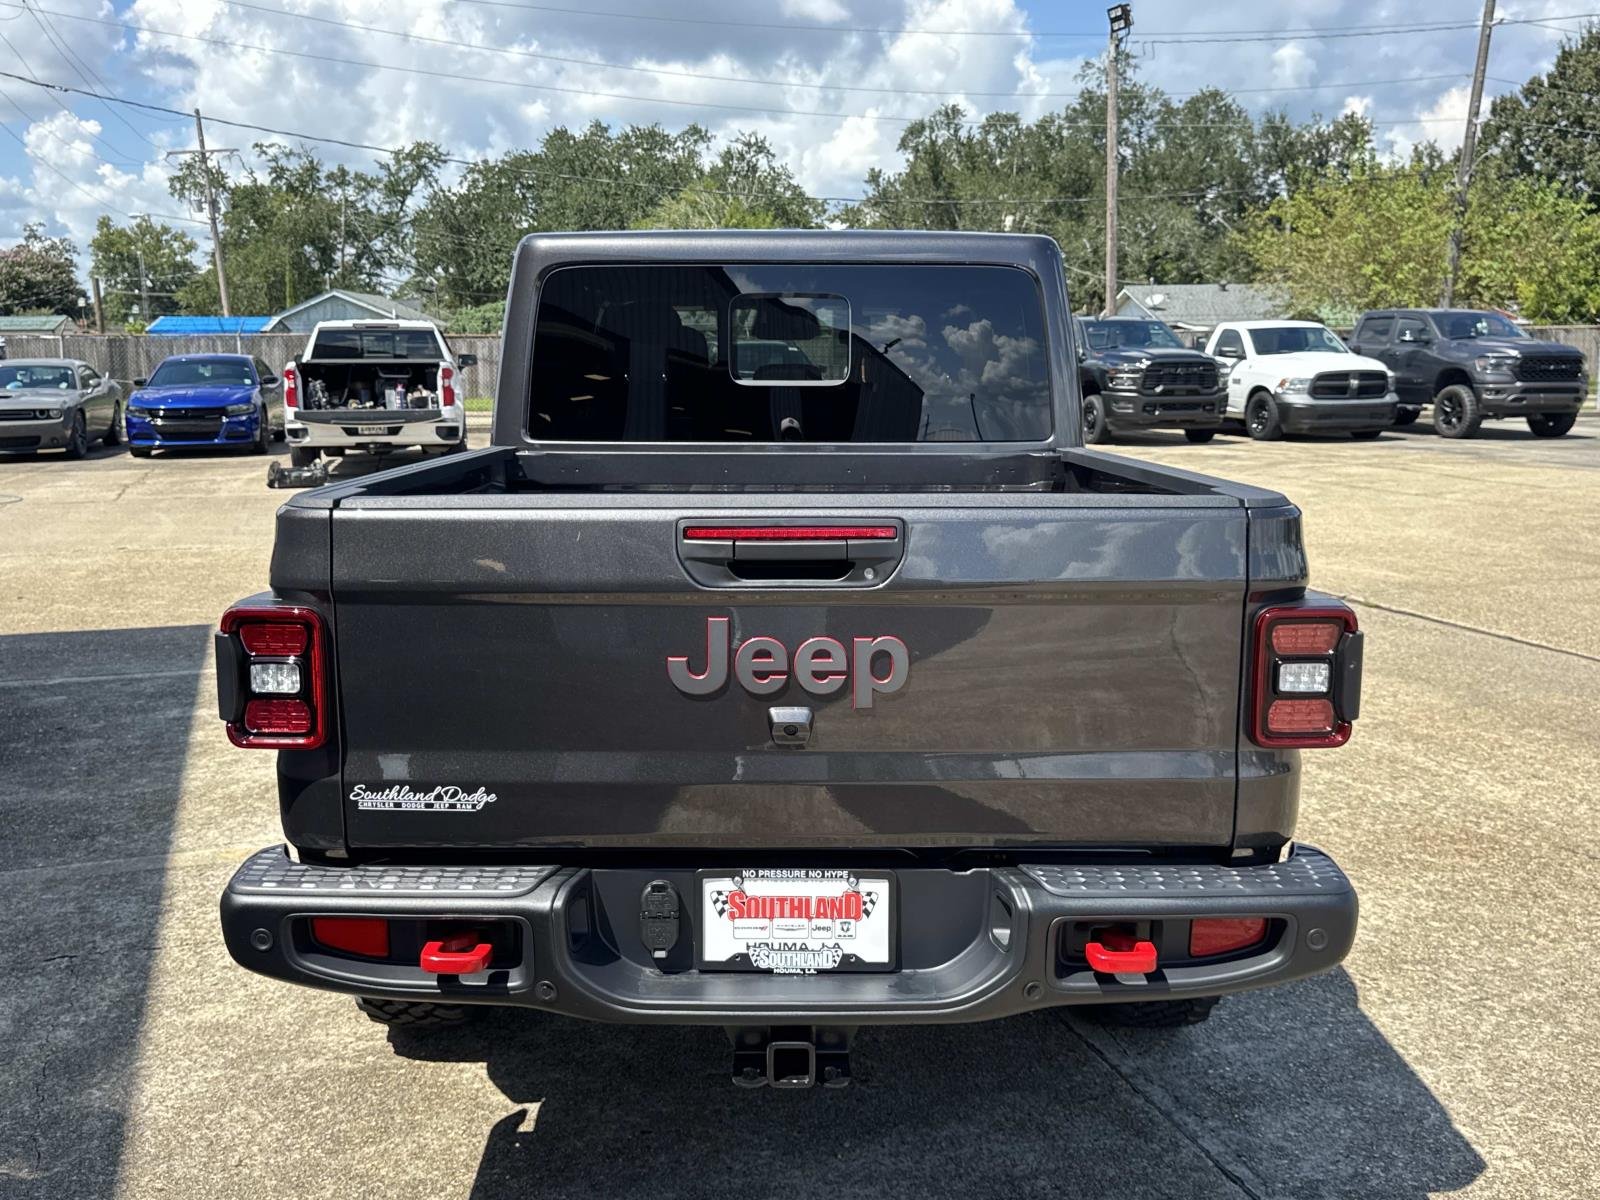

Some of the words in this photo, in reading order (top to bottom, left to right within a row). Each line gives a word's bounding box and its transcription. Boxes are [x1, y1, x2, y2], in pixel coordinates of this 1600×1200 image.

[666, 616, 910, 711] Jeep
[349, 784, 441, 801] Southland
[441, 785, 498, 810] Dodge
[742, 869, 756, 878] NO
[758, 870, 806, 878] PRESSURE
[808, 870, 823, 878] NO
[824, 870, 849, 879] HYPE
[727, 890, 864, 921] SOUTHLAND
[759, 949, 833, 967] SOUTHLAND
